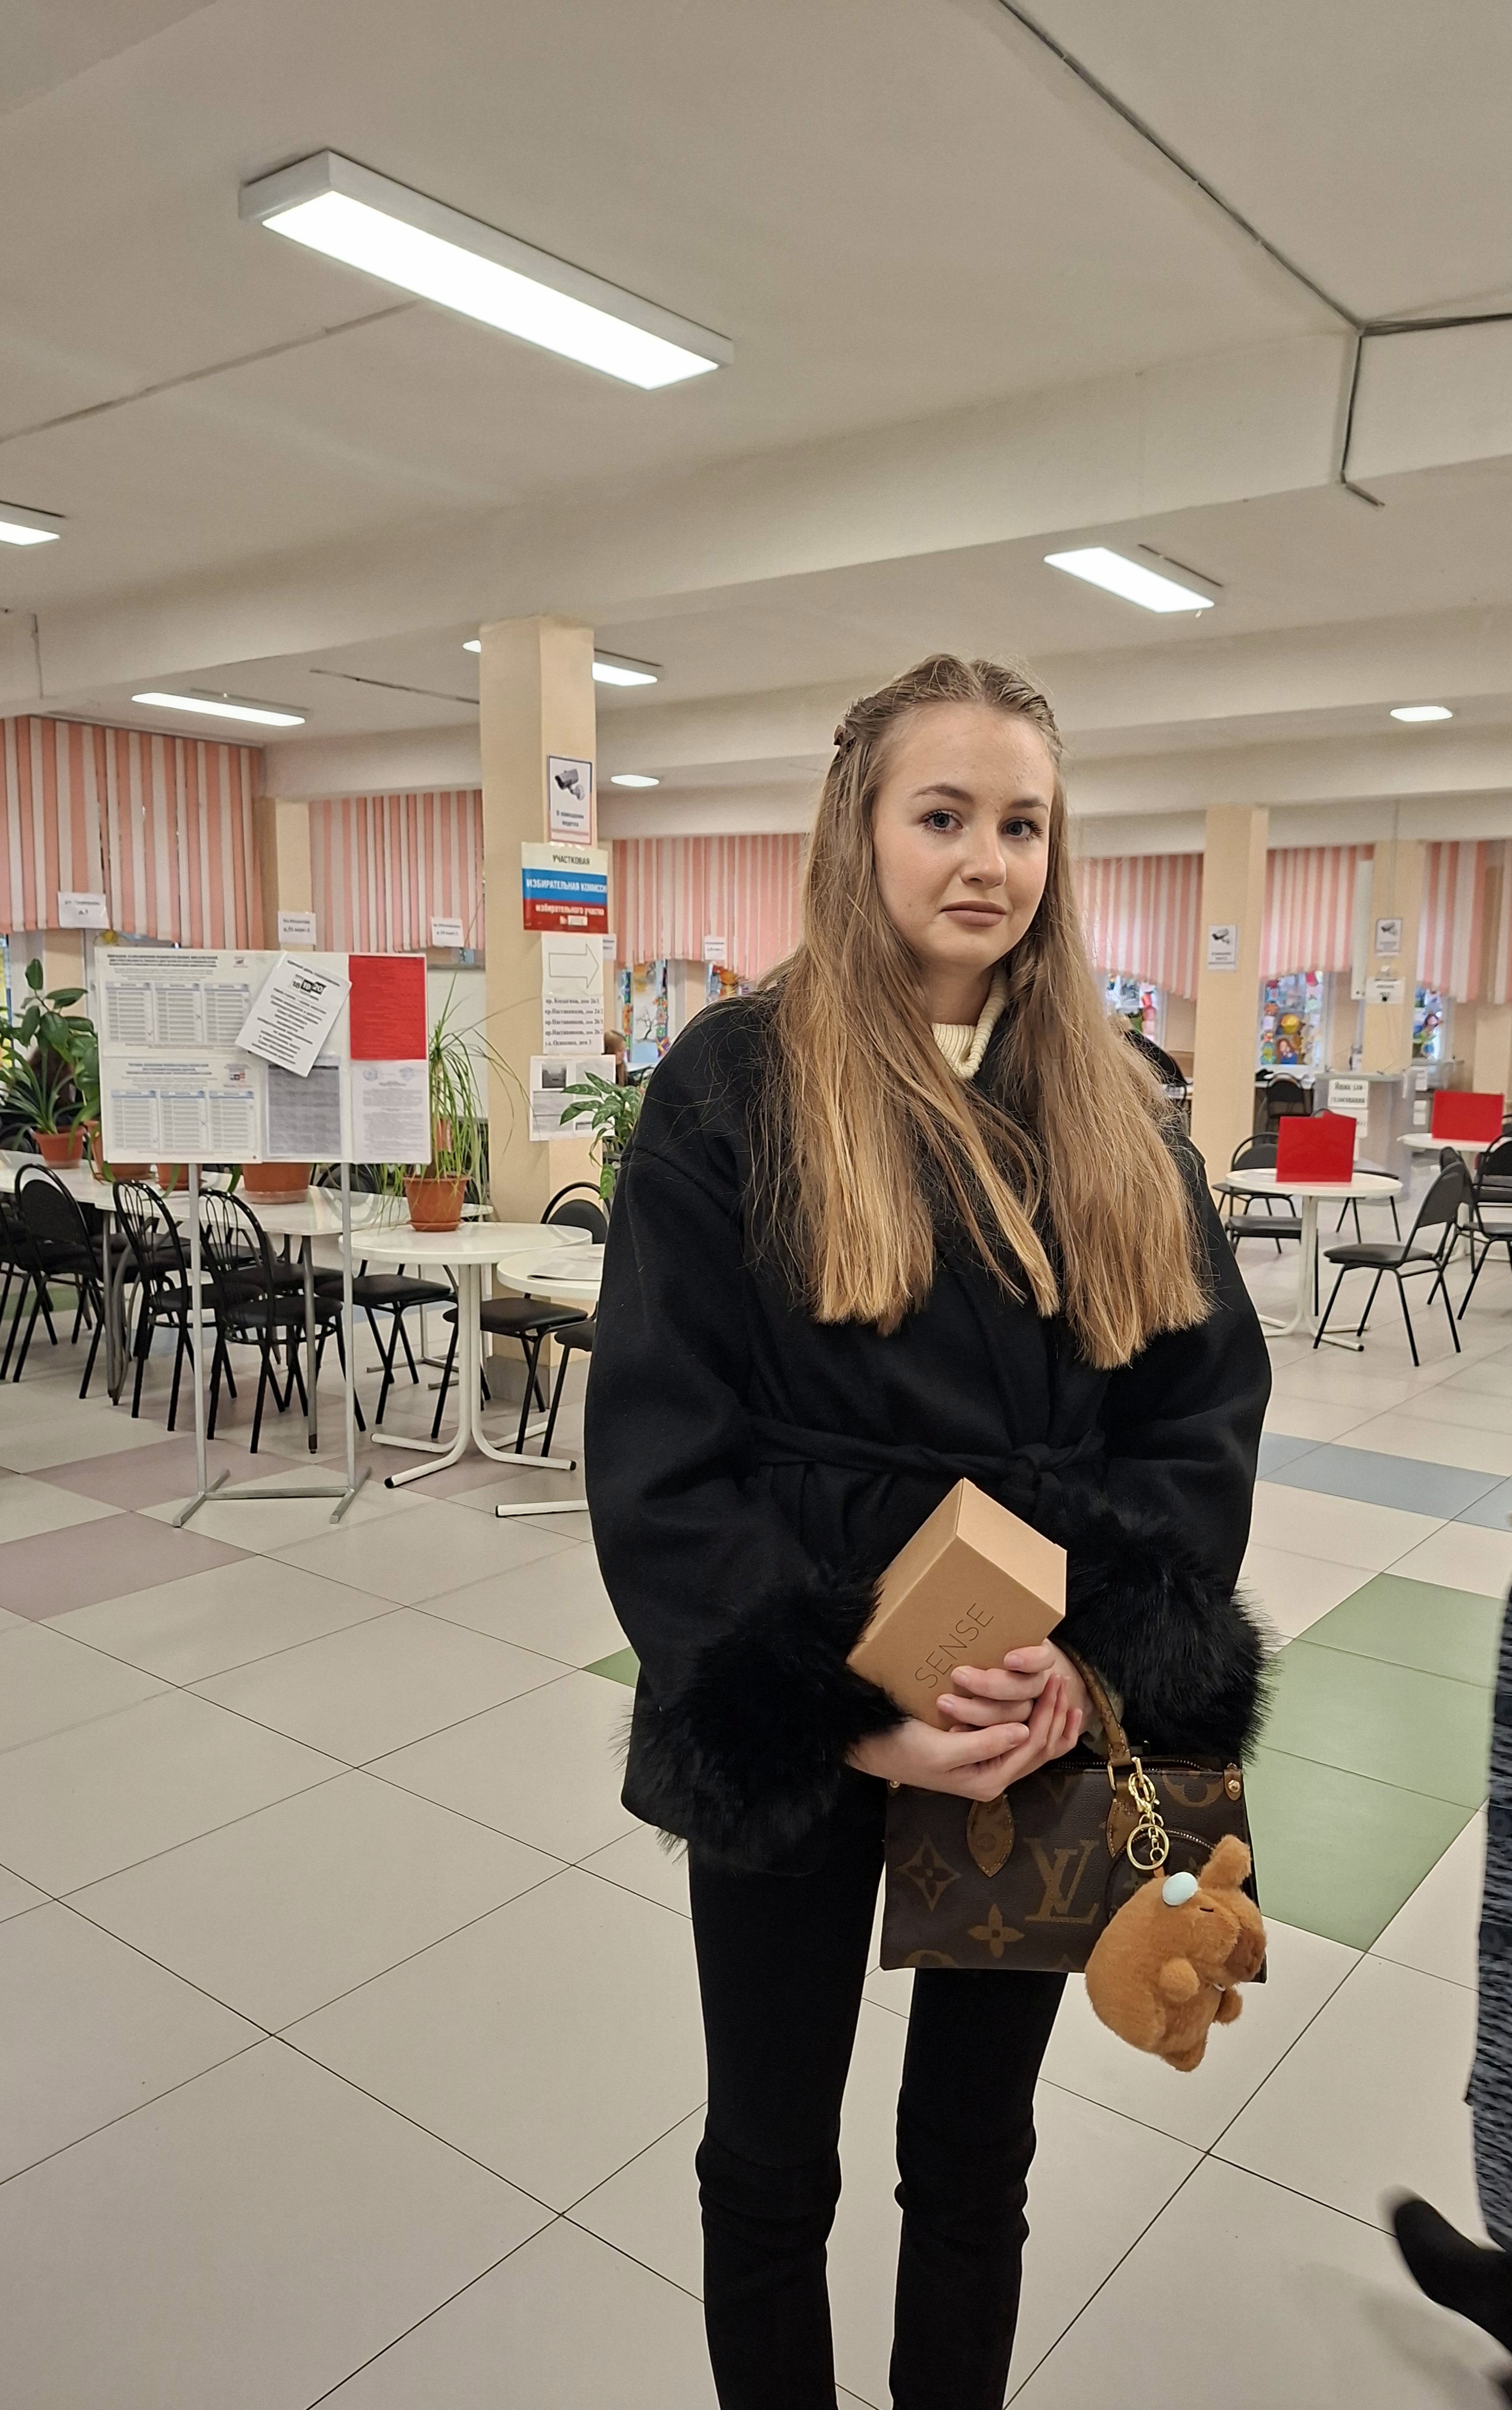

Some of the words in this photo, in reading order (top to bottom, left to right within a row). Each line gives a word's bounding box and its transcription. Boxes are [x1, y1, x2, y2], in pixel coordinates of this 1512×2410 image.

[552, 854, 590, 865] УЧАСТКОВАЯ
[526, 878, 579, 890] ИЗБИРАТЕЛЬНАЯ
[302, 981, 311, 990] 19
[312, 983, 323, 992] 20
[914, 1602, 994, 1689] SENSE
[1024, 1836, 1099, 1925] LV
